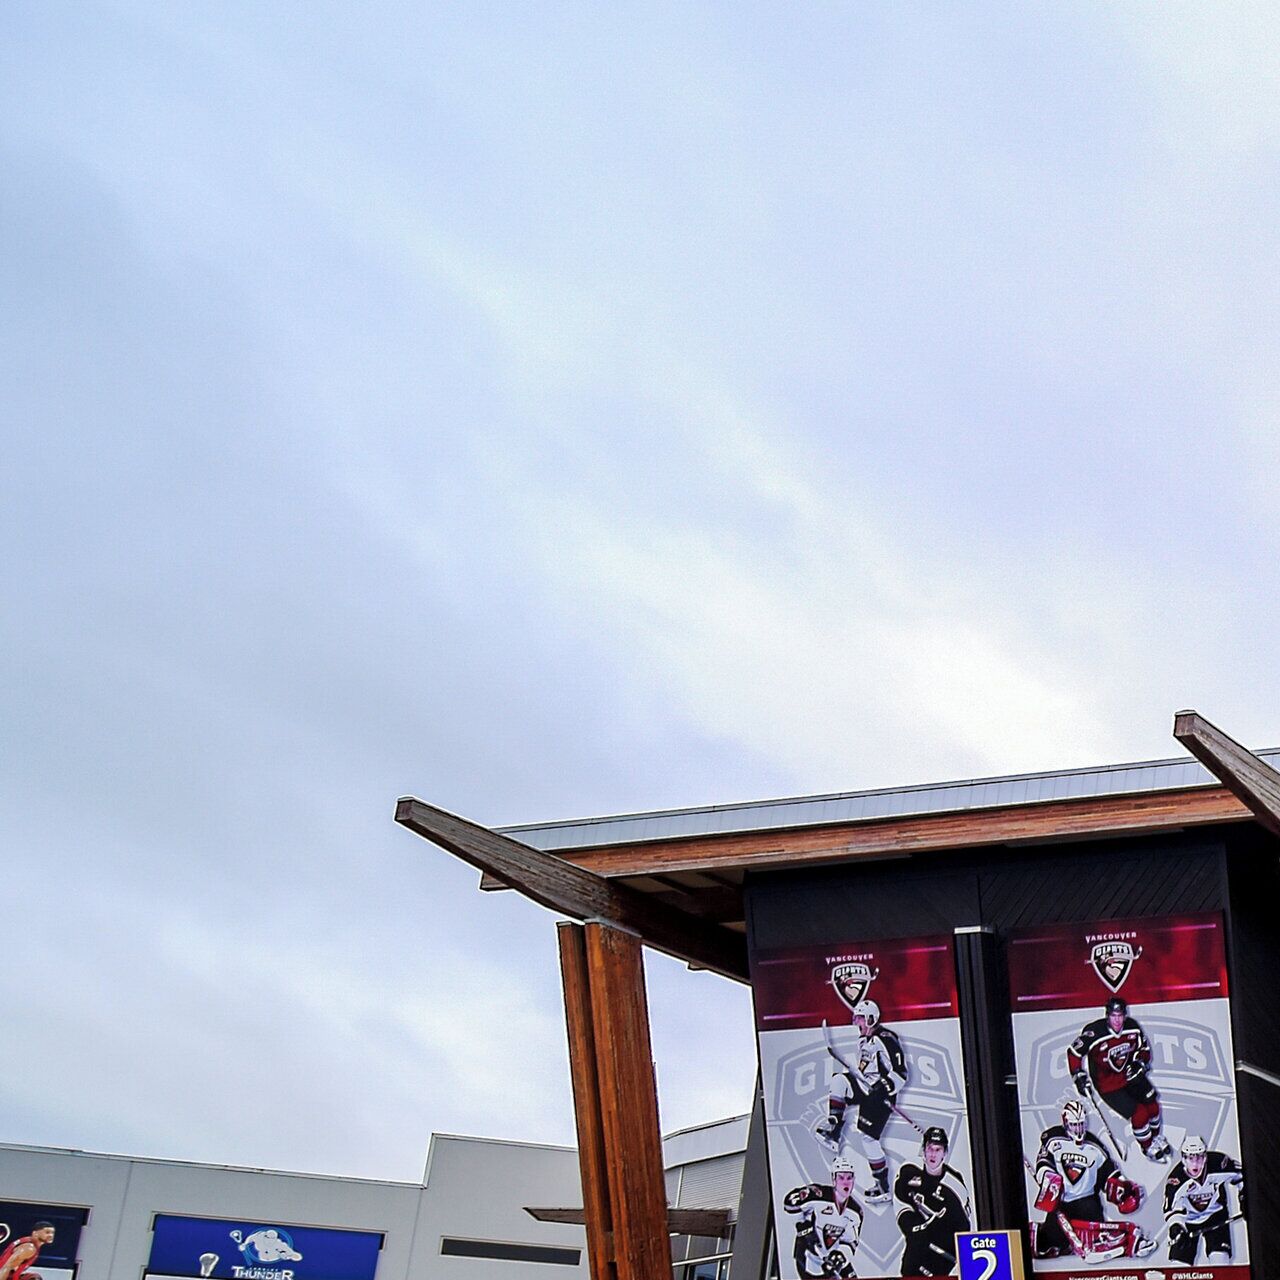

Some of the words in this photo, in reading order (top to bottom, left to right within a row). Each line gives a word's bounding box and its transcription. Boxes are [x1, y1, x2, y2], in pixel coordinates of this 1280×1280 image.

[1085, 931, 1137, 944] VANCOUVER
[1095, 945, 1130, 957] GIANTS
[825, 953, 874, 965] VANCOUVER
[971, 1237, 997, 1249] Gate
[1172, 1273, 1214, 1280] @WHLGiants
